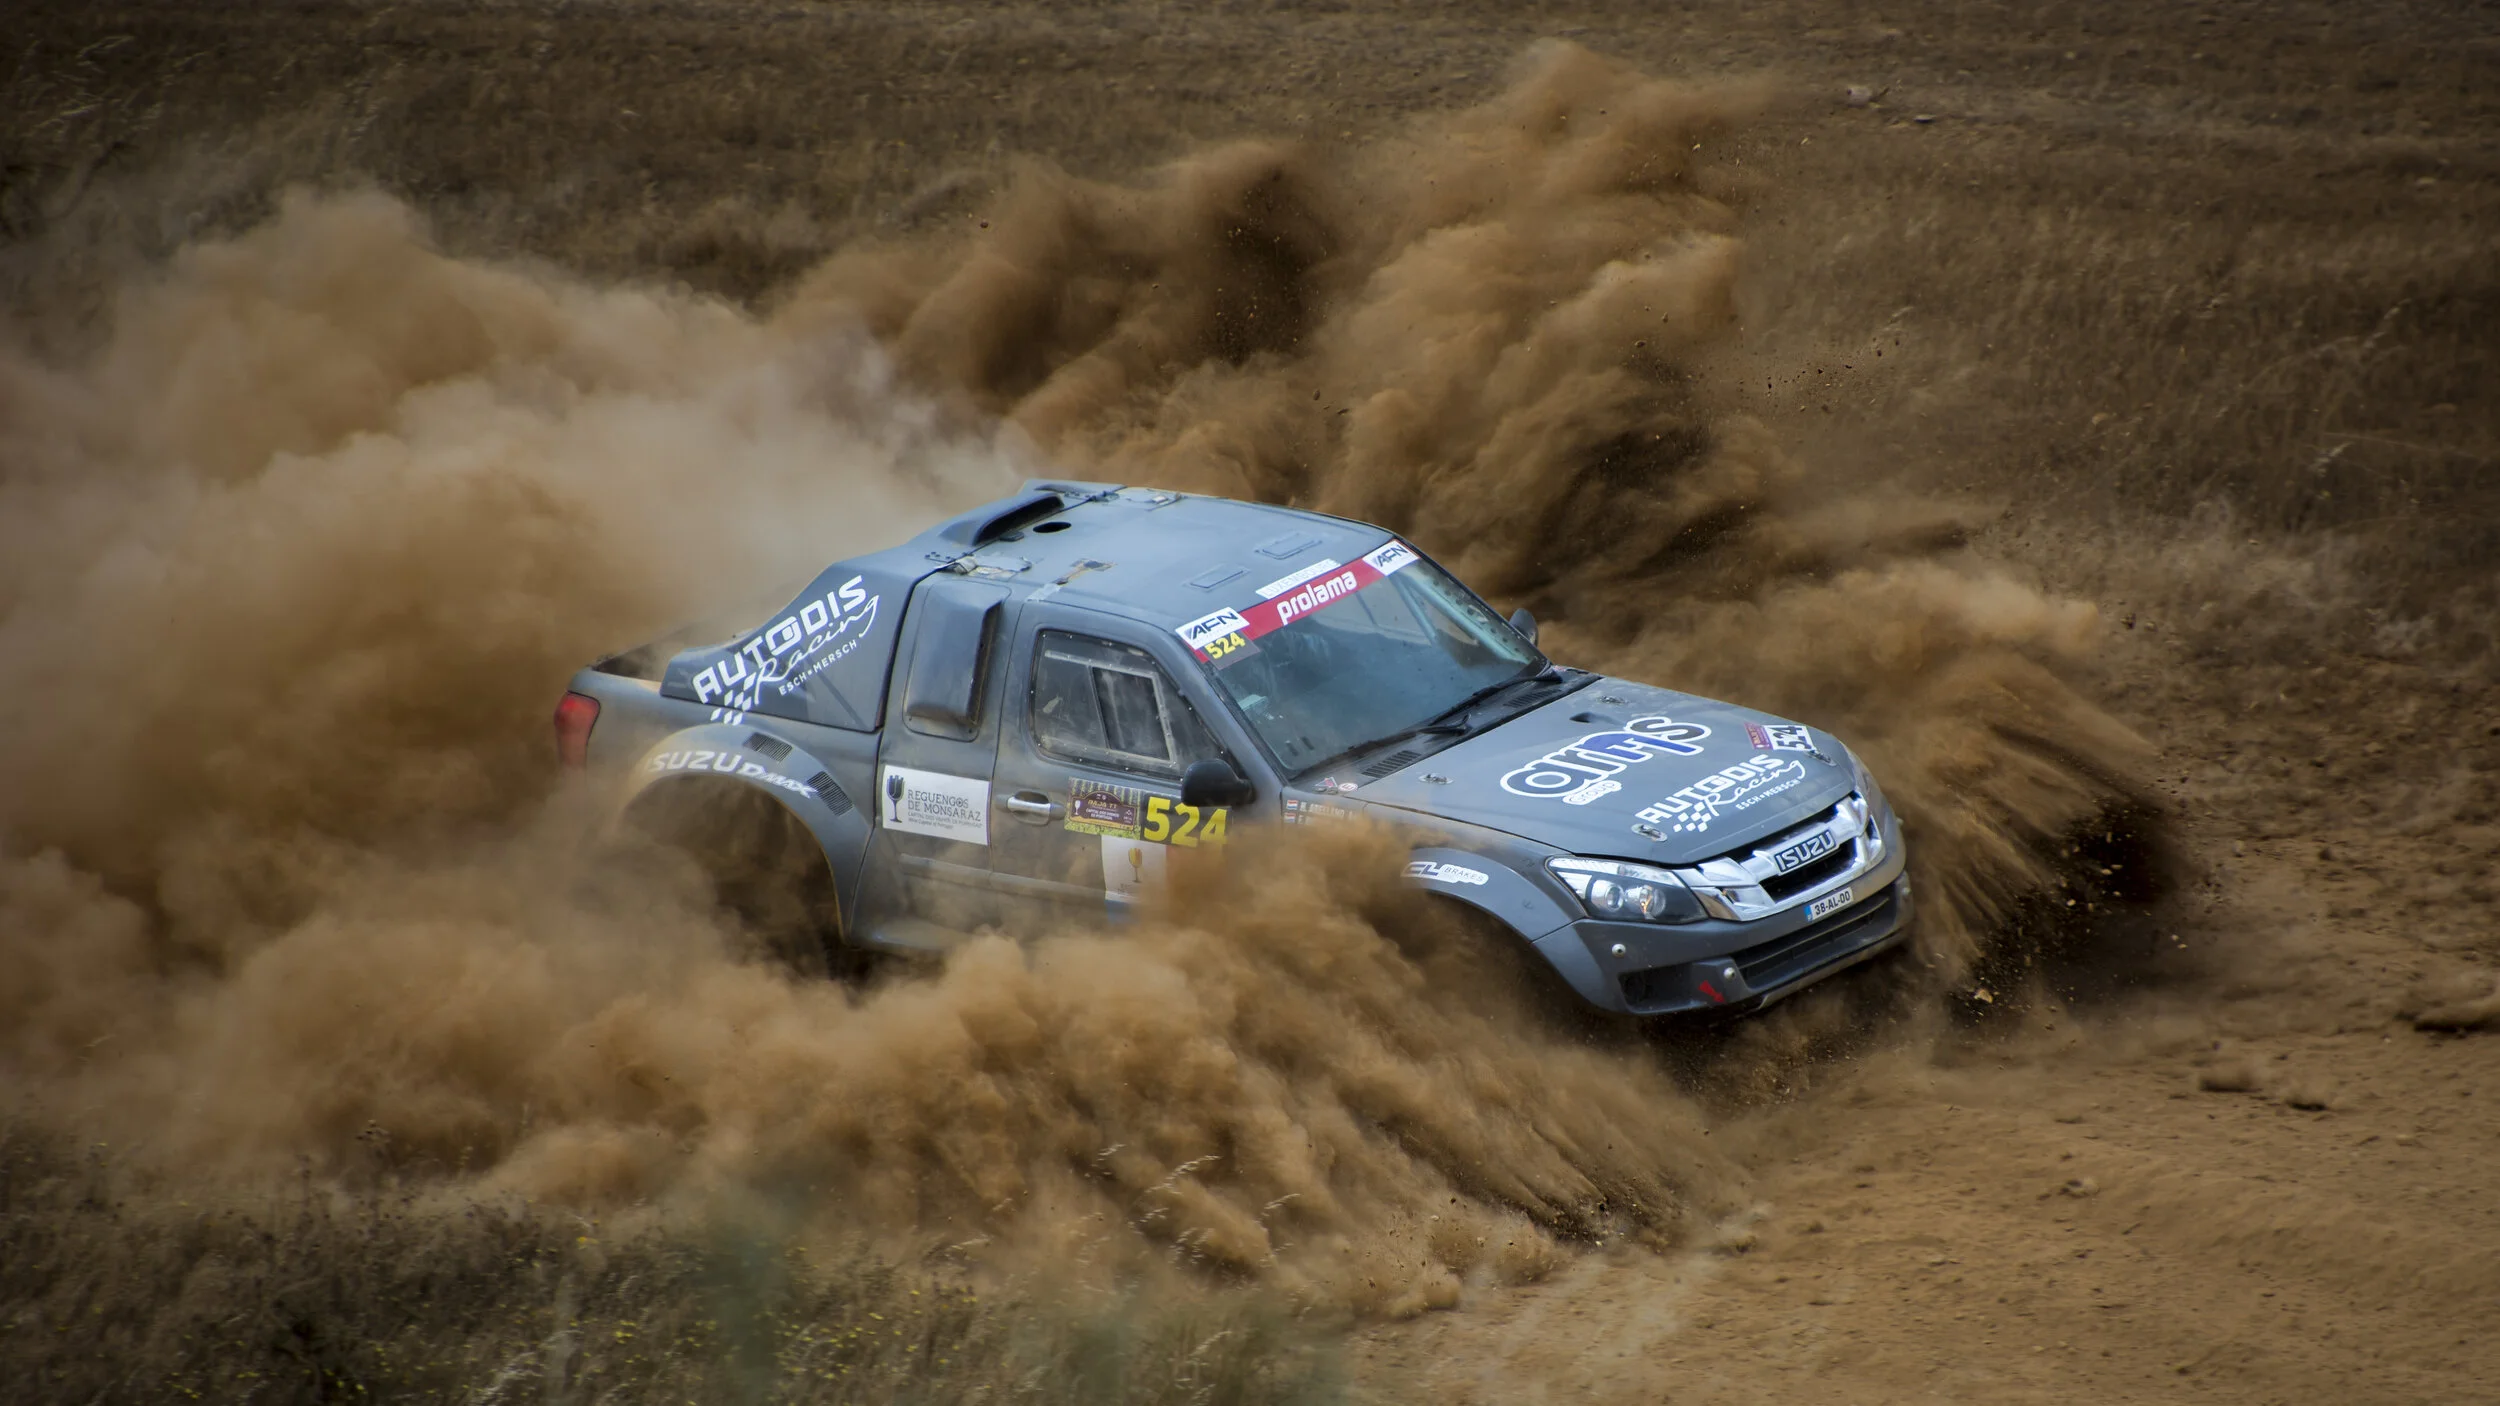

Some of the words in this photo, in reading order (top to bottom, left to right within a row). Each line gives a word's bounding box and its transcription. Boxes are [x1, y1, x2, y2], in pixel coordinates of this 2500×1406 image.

[1377, 545, 1409, 567] AFN
[1276, 571, 1357, 626] prolama
[692, 575, 866, 704] AUTODIS
[1191, 612, 1239, 640] AFN
[754, 595, 879, 706] Racing
[1204, 632, 1246, 659] 524
[1769, 726, 1812, 749] 524
[646, 751, 742, 773] SUZU
[907, 789, 969, 809] REGUENGOS
[1635, 754, 1785, 824] AUTODIS
[1704, 760, 1805, 817] Racing
[907, 800, 921, 812] DE
[923, 803, 981, 822] MONSARAZ
[1144, 796, 1227, 848] 524
[1775, 831, 1835, 871] ISUZU
[1814, 890, 1851, 916] 38-AL-00
